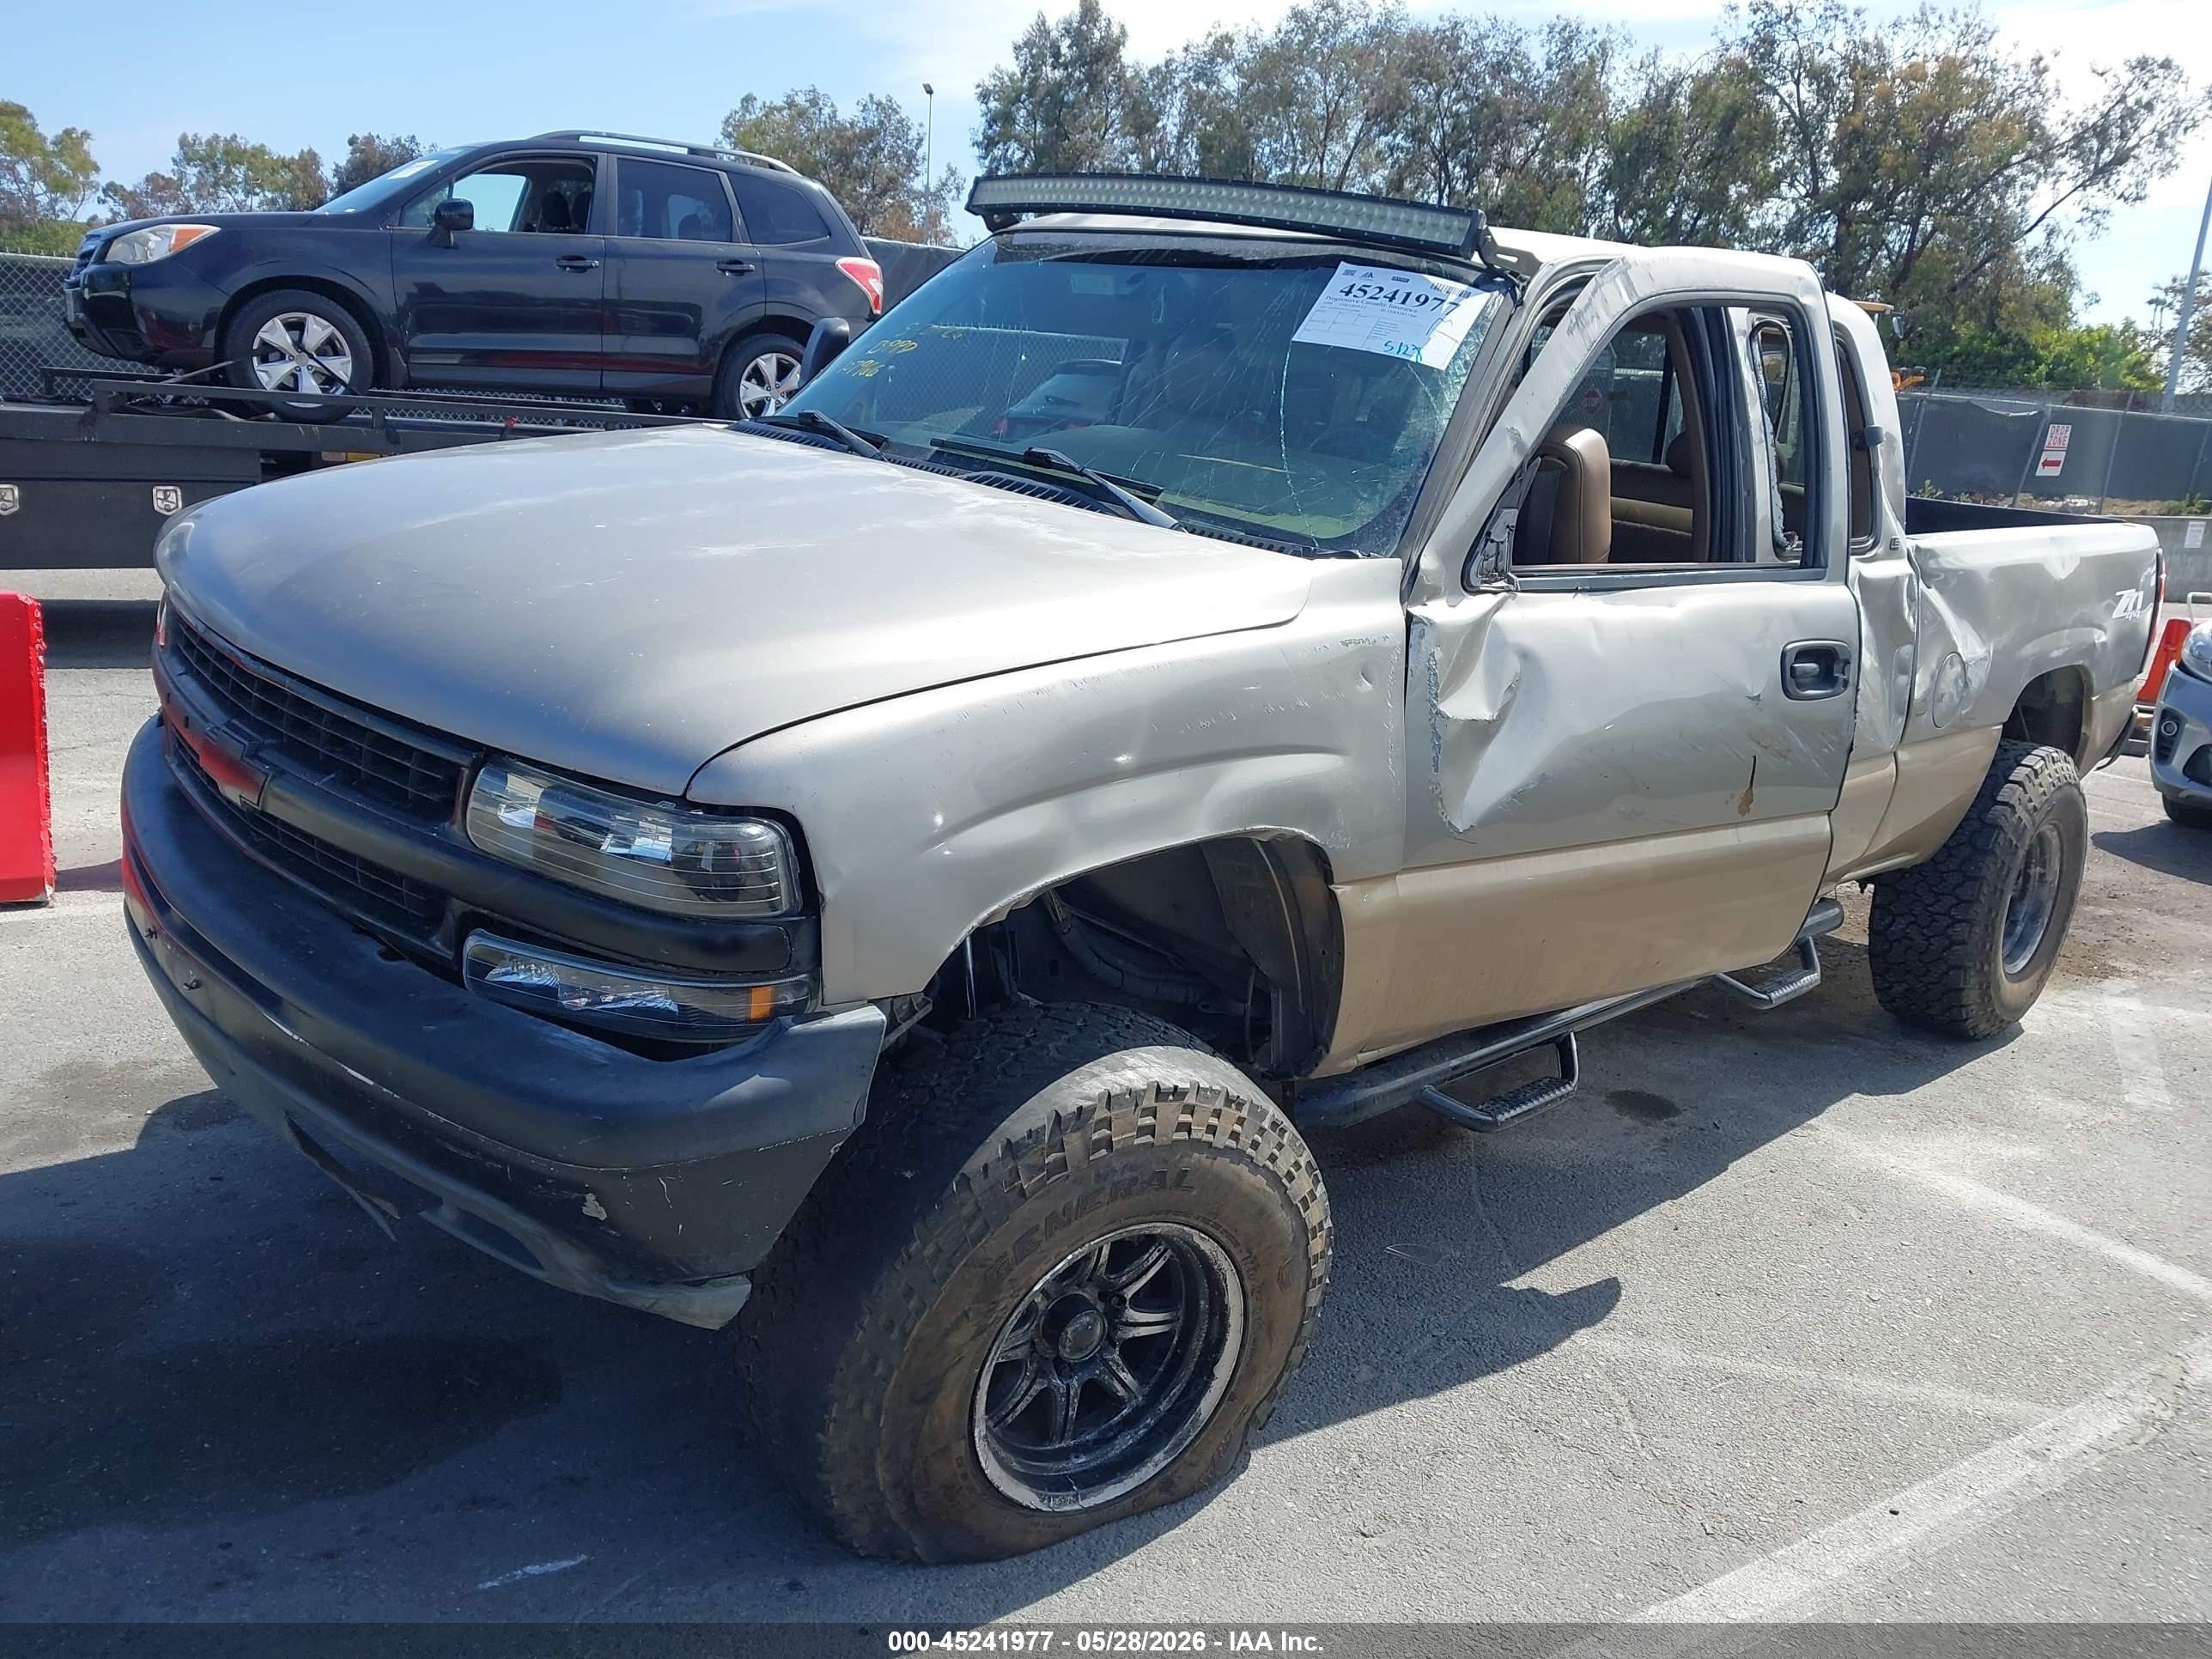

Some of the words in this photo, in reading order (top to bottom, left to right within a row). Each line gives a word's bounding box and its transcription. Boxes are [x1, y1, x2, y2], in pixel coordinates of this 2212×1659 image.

[1339, 282, 1461, 316] 45241977
[2047, 435, 2068, 446] ZONE
[2050, 425, 2069, 435] DROP
[2112, 588, 2144, 619] Z71
